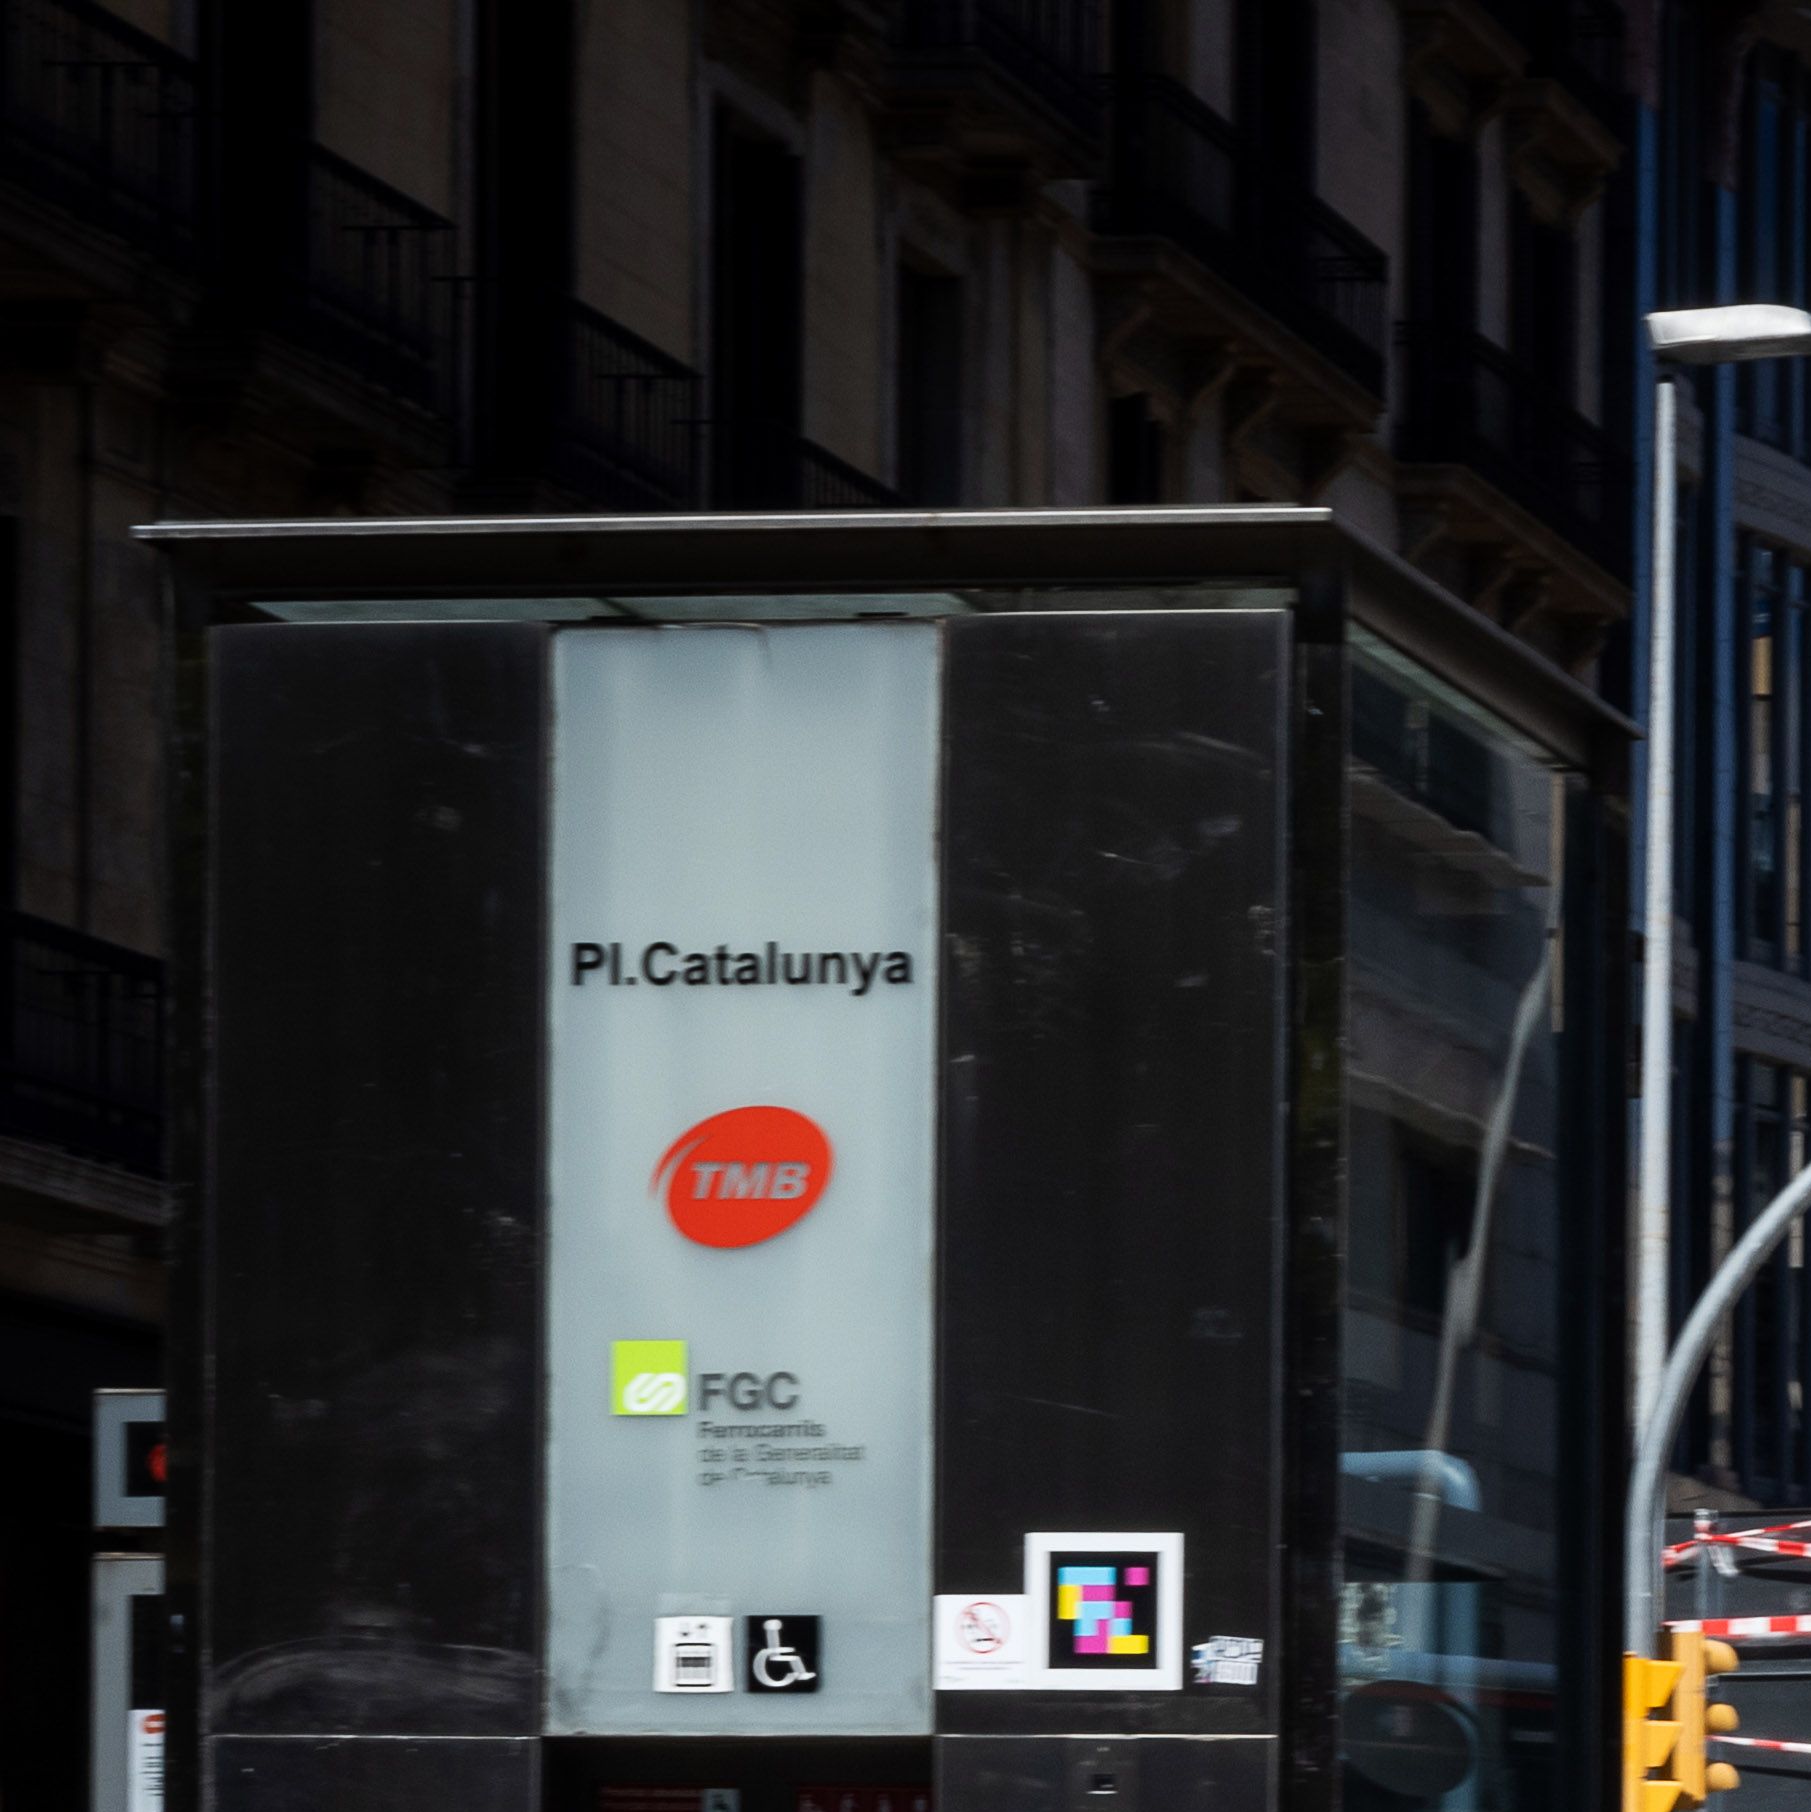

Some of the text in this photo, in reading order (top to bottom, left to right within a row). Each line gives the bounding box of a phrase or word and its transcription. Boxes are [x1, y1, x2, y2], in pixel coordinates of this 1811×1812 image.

[570, 941, 914, 996] Pl.Catalunya
[692, 1162, 811, 1200] TMB
[699, 1371, 800, 1412] FGC
